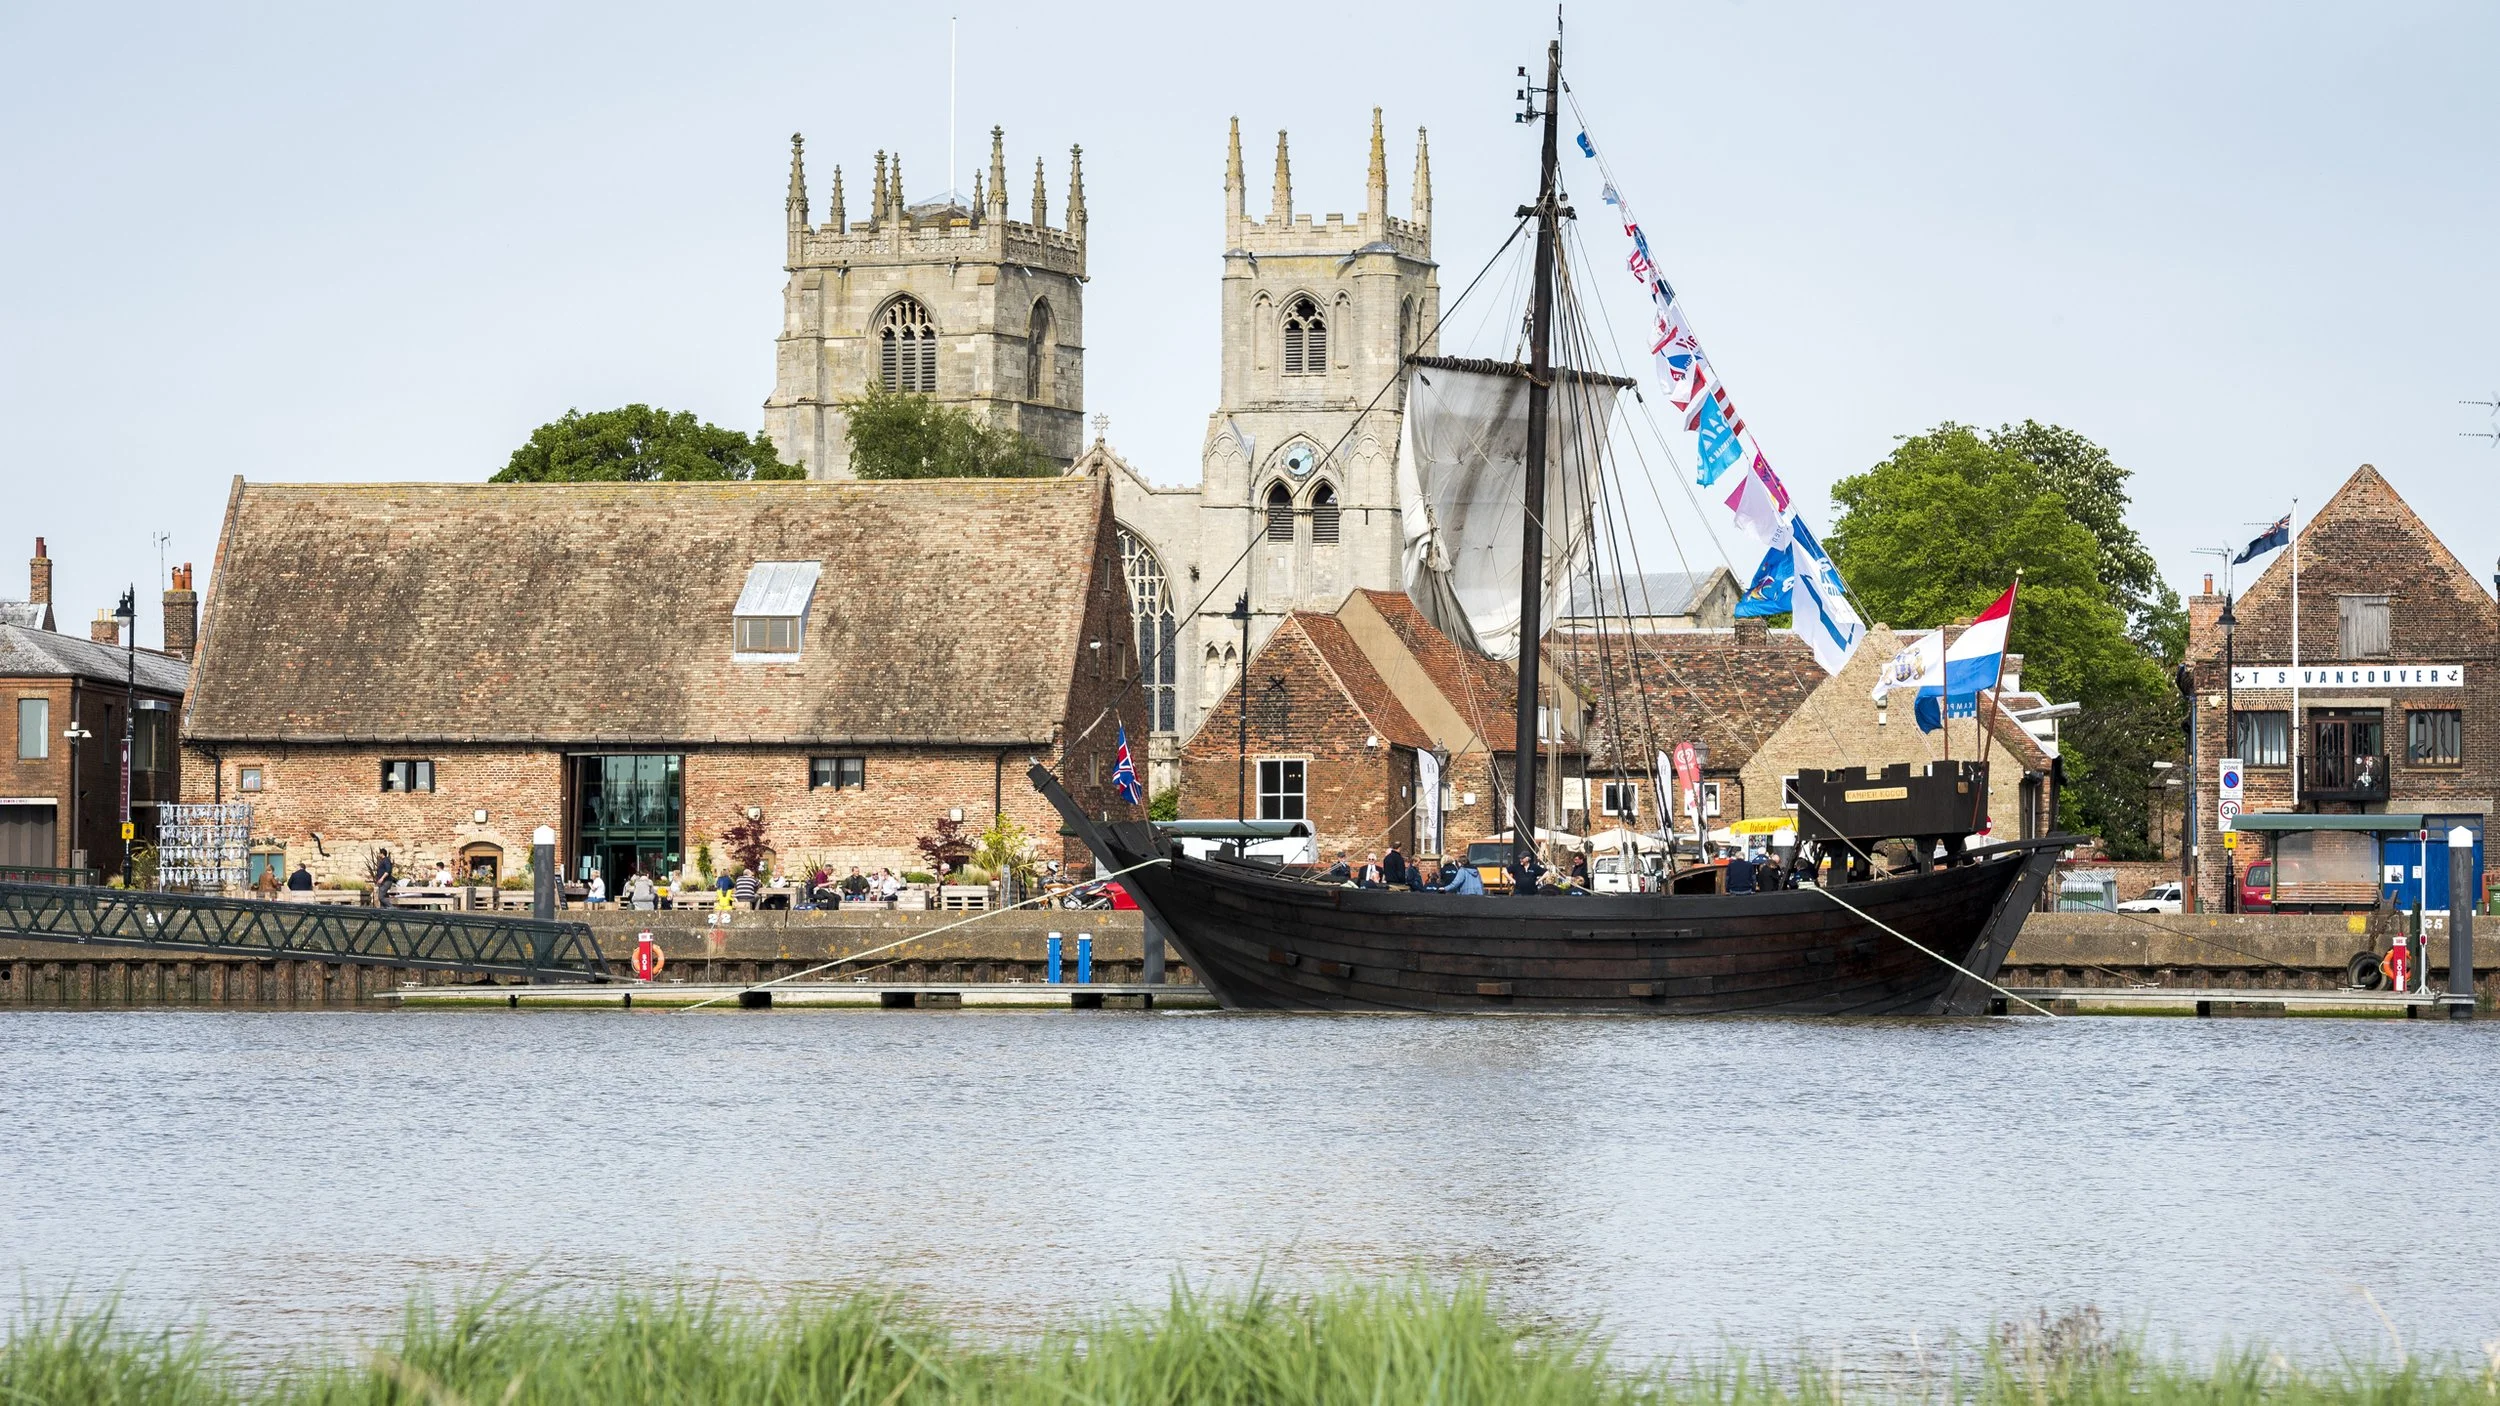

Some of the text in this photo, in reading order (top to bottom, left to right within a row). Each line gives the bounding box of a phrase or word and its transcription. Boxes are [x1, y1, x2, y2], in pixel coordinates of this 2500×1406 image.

[2253, 670, 2438, 684] T S VANCOUVER
[2223, 806, 2237, 815] 30
[1749, 823, 1766, 832] Italian
[707, 913, 731, 924] 22
